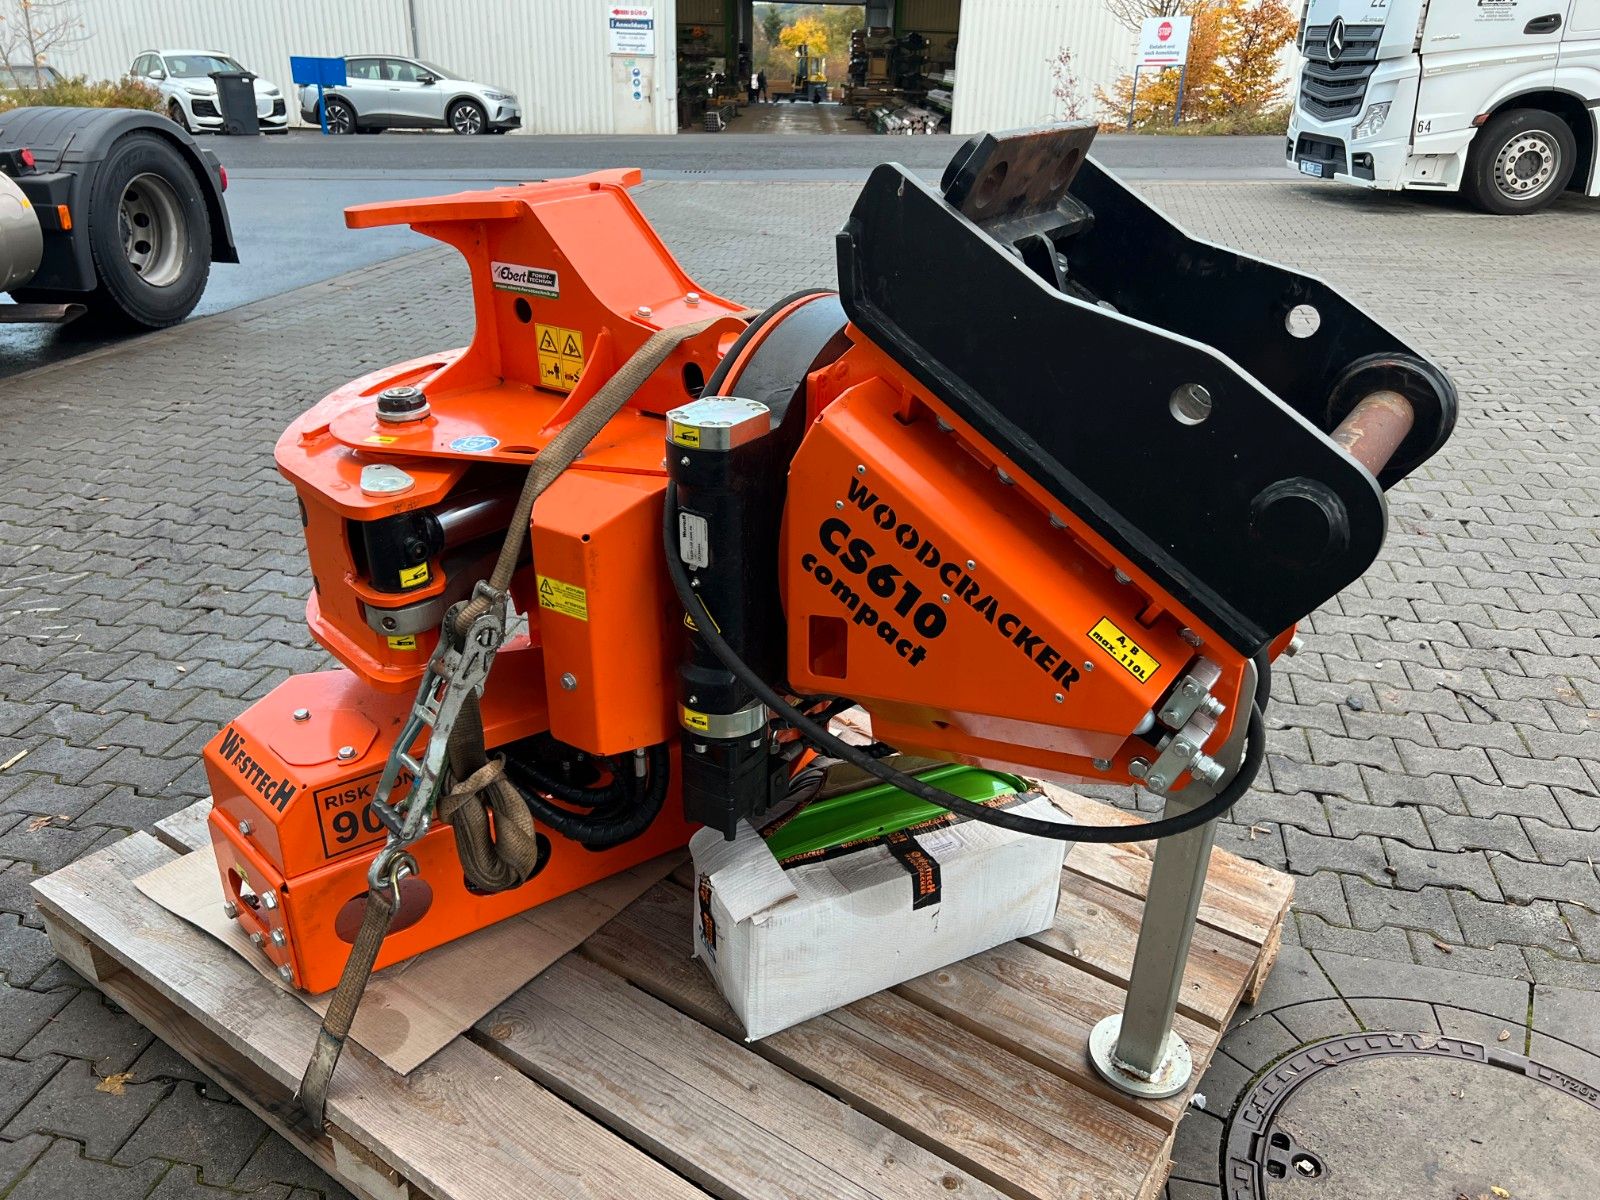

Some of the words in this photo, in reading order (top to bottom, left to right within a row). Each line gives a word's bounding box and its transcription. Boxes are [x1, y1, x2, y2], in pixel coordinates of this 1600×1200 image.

[615, 21, 648, 30] Anmeldung
[1160, 27, 1172, 36] STOP
[1417, 120, 1431, 133] 64
[500, 266, 526, 283] Ebert
[818, 517, 947, 640] CS610
[847, 477, 1080, 693] WOODCRACKER
[801, 552, 927, 668] compact
[1092, 631, 1117, 655] max.
[1120, 653, 1146, 679] 110L
[1130, 645, 1140, 656] B
[219, 727, 297, 814] WESTTECH
[324, 784, 371, 811] RISK
[332, 803, 390, 844] 90
[779, 848, 827, 867] OODCRACKER
